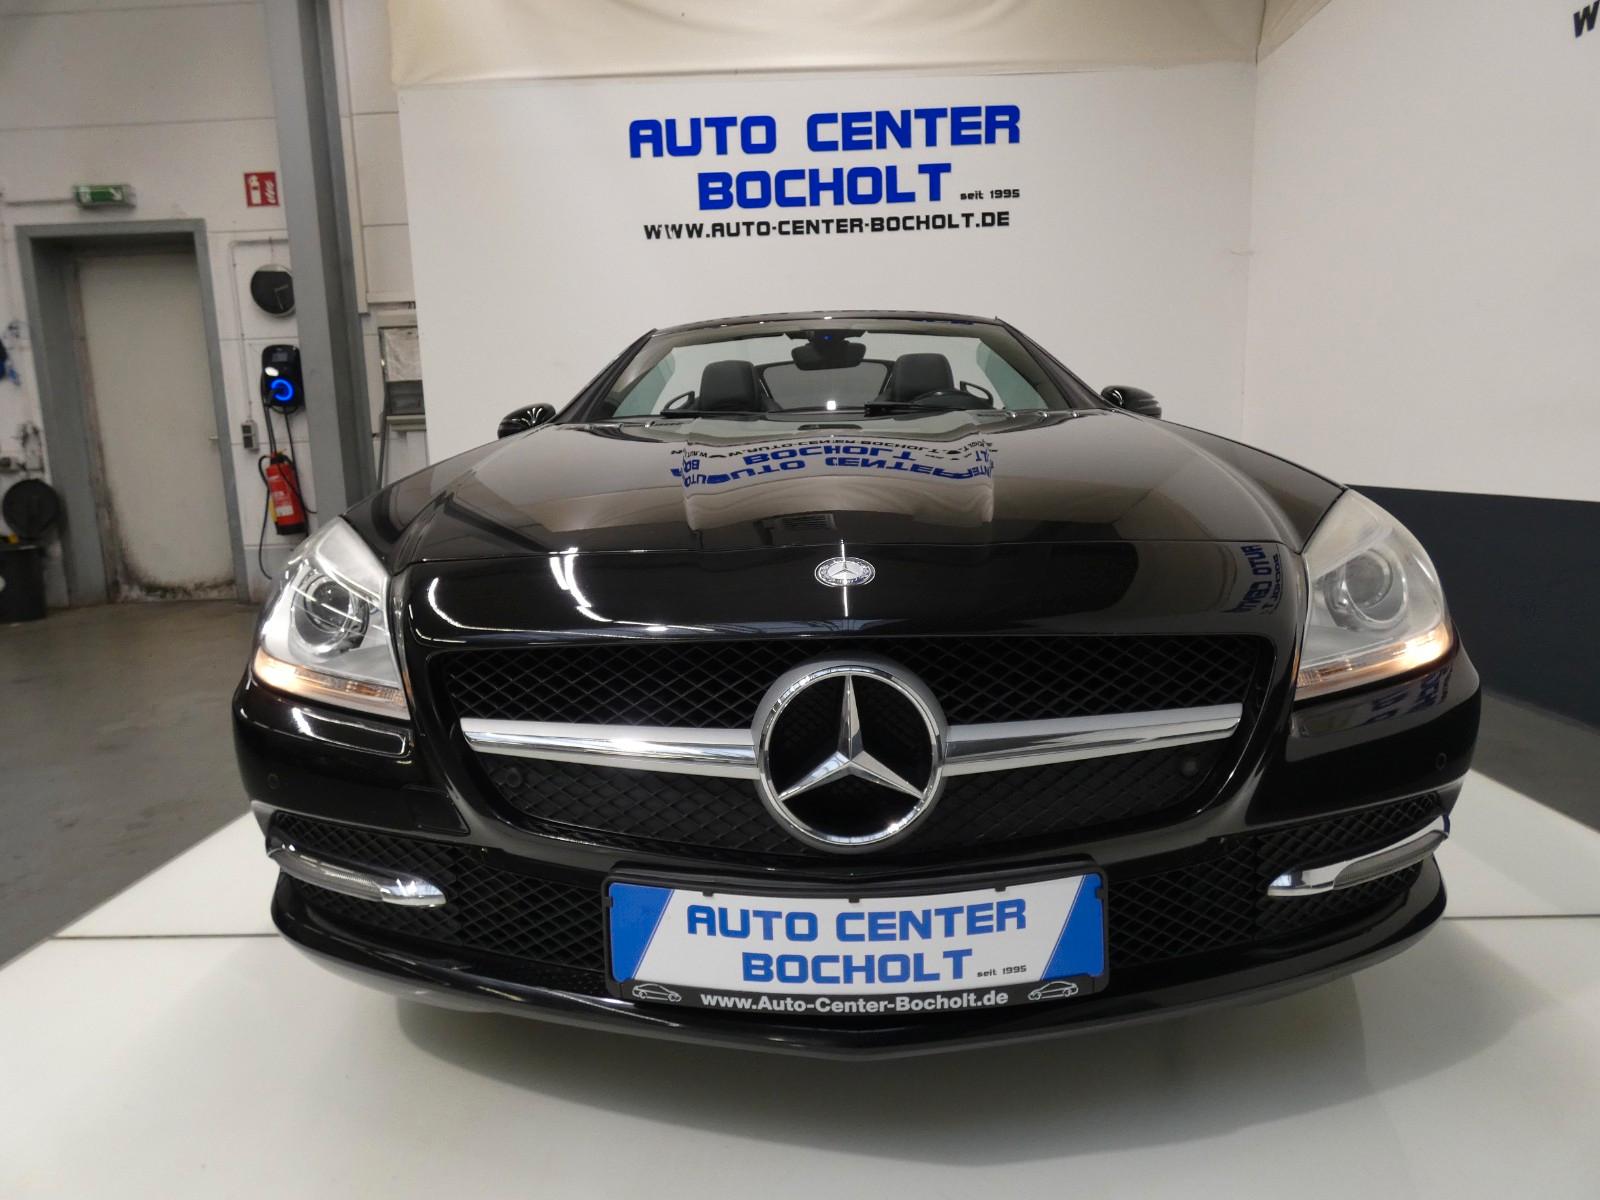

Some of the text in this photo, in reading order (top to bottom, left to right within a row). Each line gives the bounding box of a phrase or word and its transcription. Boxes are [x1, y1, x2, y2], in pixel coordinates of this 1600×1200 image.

[629, 104, 1021, 159] AUTO CENTER
[698, 163, 1020, 211] BOCHOLT seit 1995
[643, 211, 1010, 240] WWW.AUTO-CENTER-BOCHOLT.DE
[687, 898, 1026, 942] AUTO CENTER
[742, 948, 1027, 985] BOCHOLT seit 1995
[700, 990, 1009, 1013] www.Auto-Center-Bocholt.de
